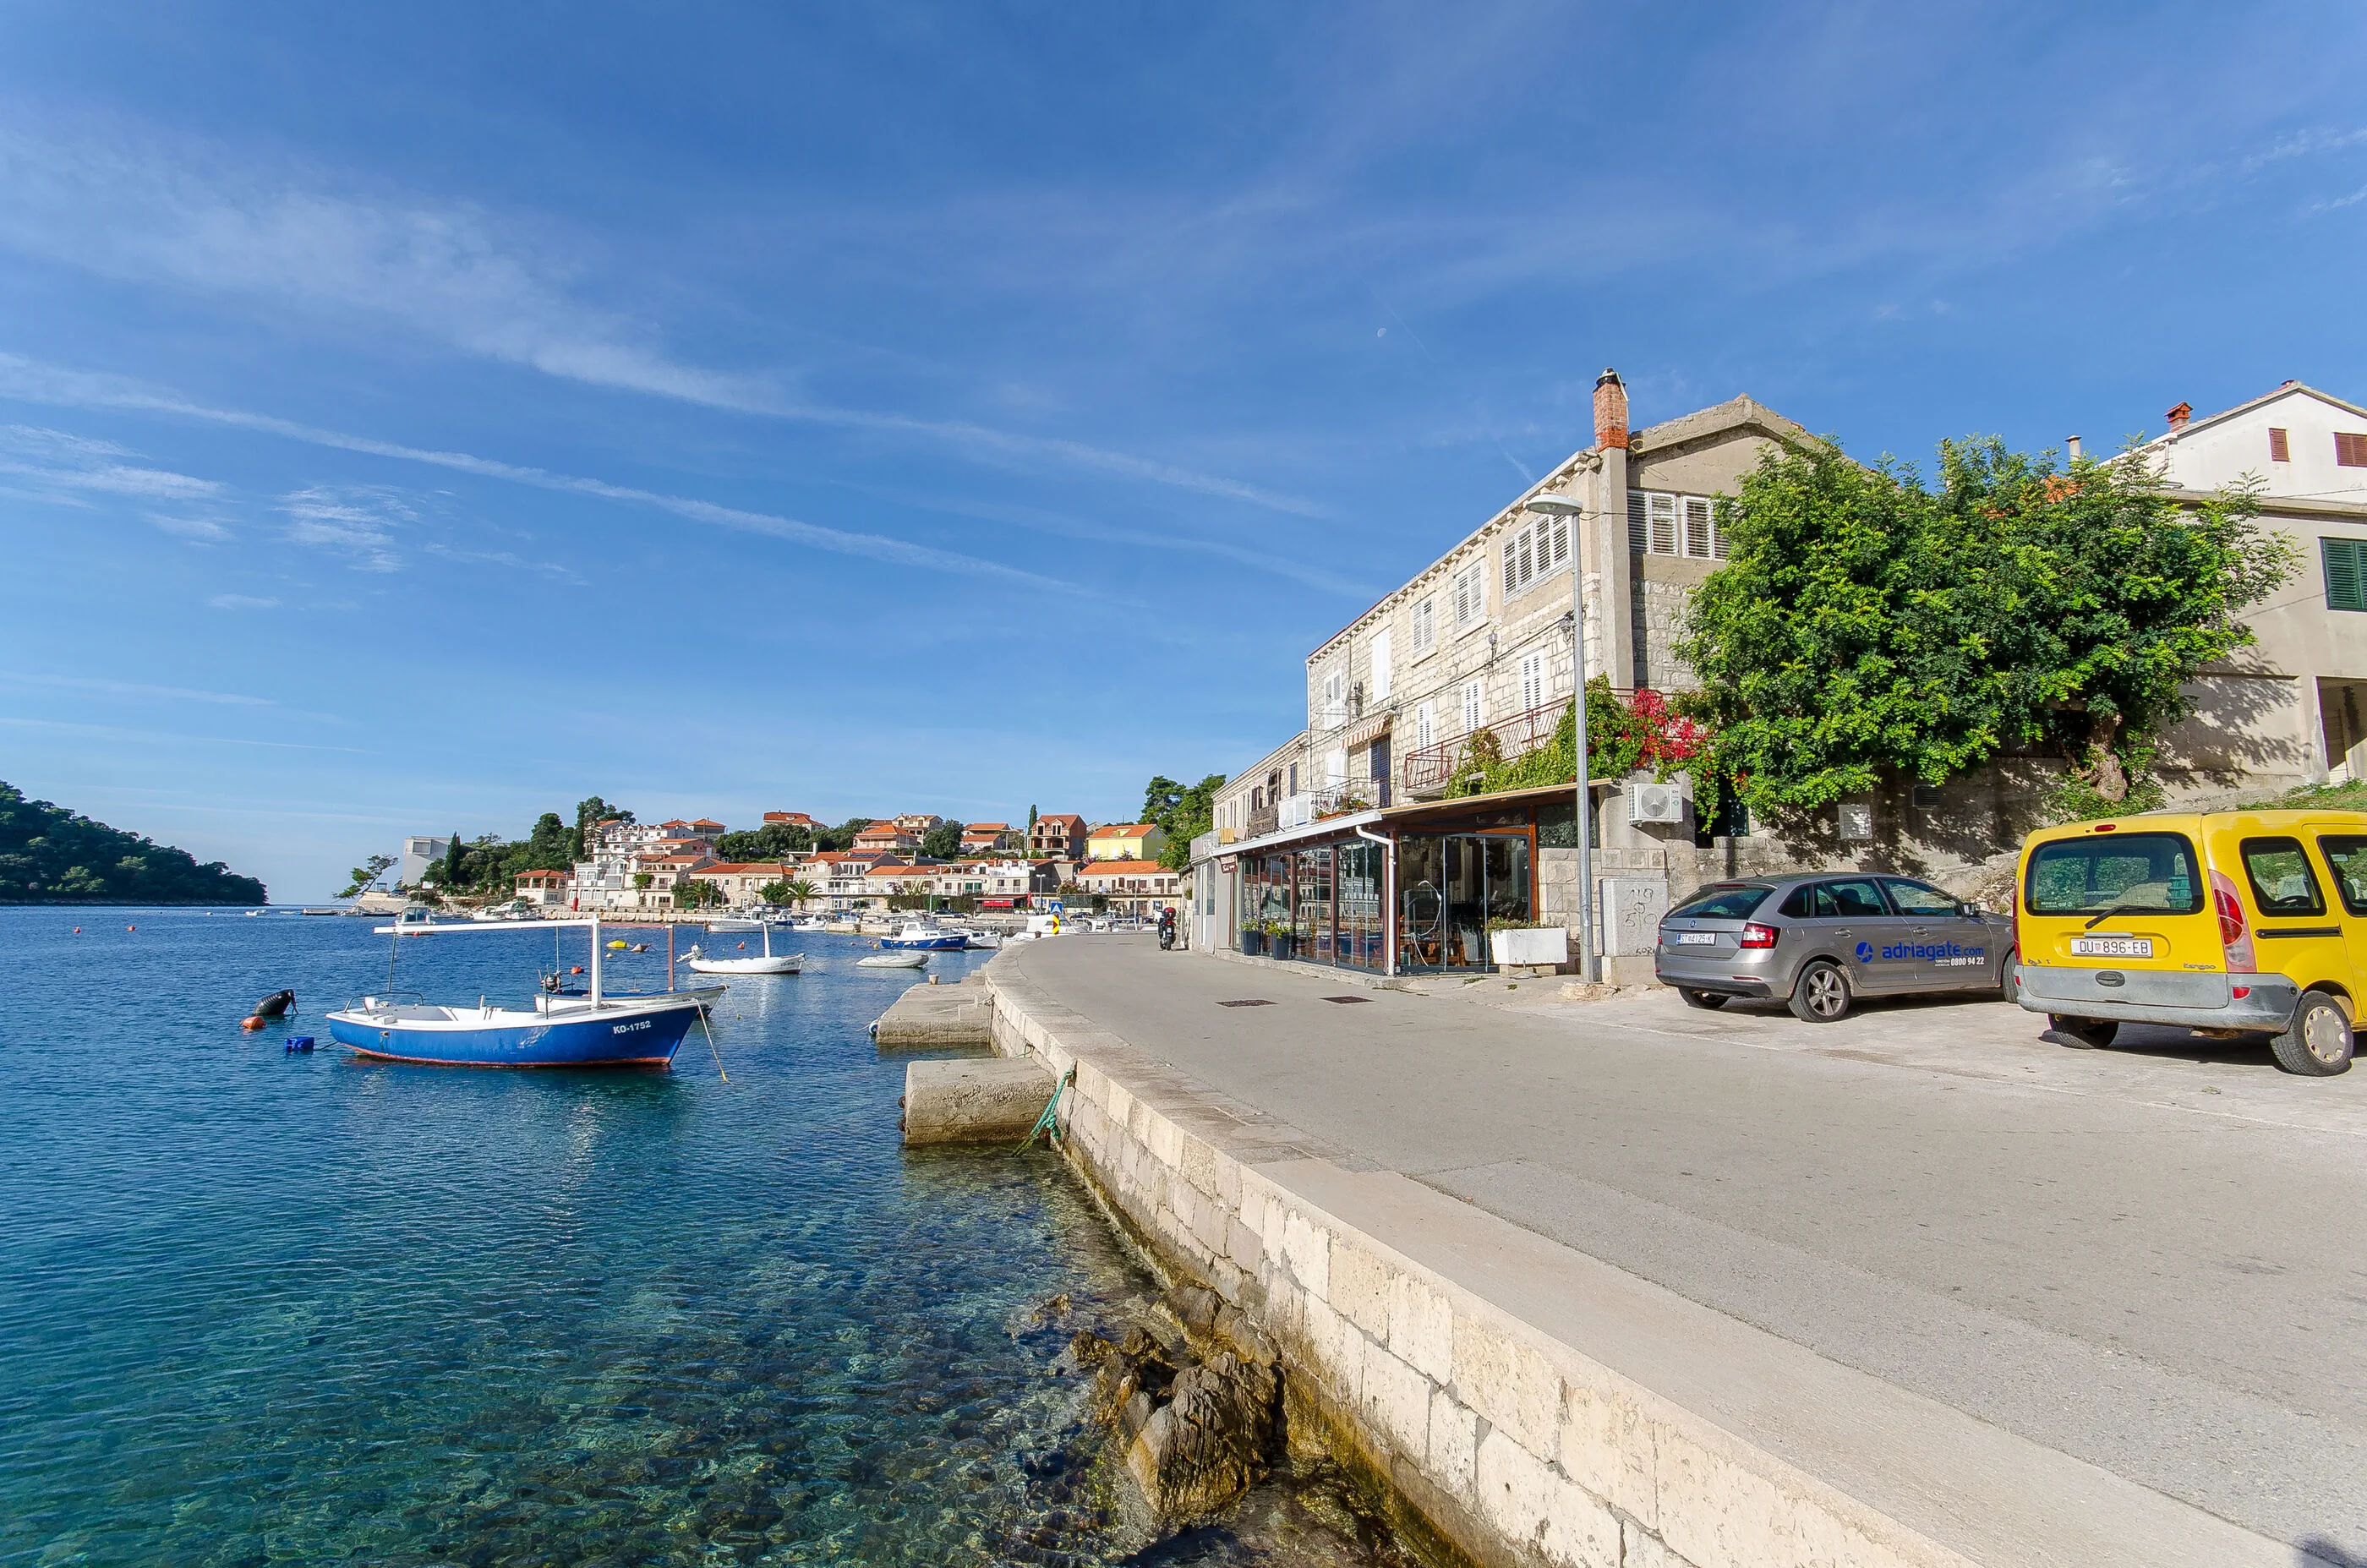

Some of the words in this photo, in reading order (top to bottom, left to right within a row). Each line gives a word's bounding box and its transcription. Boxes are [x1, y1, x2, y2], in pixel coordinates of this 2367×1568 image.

[1882, 940, 1984, 961] adriagate.com
[2080, 941, 2094, 953] DU
[2102, 941, 2148, 954] 896-EB
[1950, 957, 1966, 966] 0800
[1967, 957, 1976, 965] 94
[1976, 956, 1985, 965] 22
[613, 1020, 652, 1035] KO-1752
